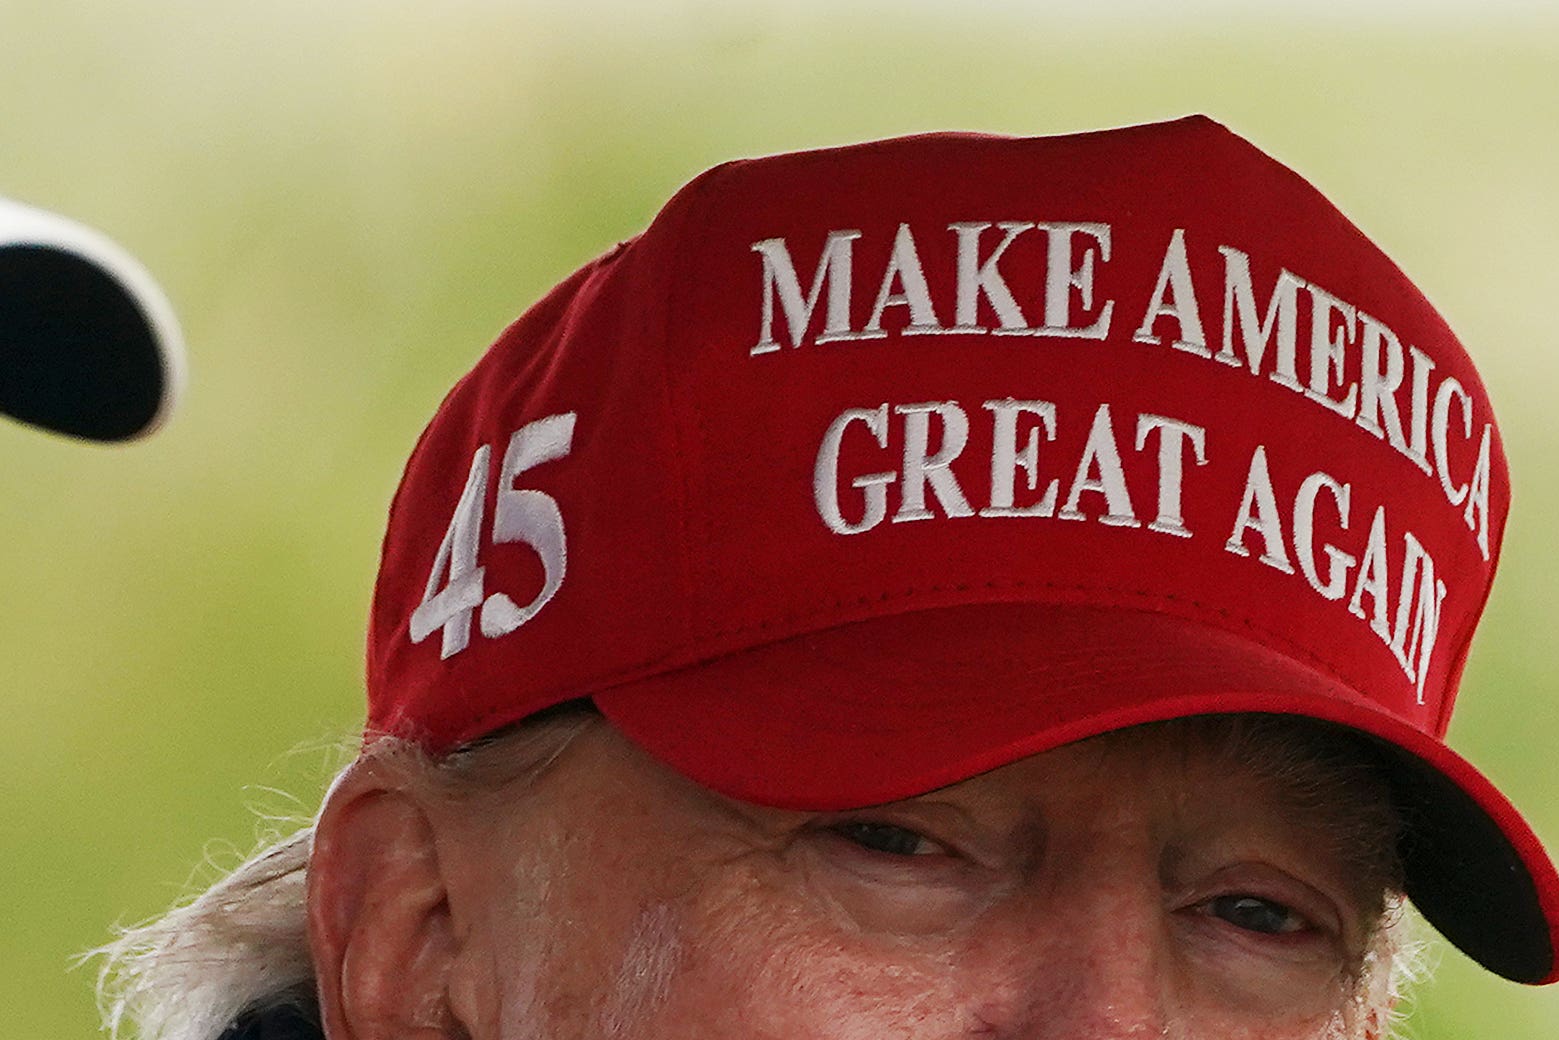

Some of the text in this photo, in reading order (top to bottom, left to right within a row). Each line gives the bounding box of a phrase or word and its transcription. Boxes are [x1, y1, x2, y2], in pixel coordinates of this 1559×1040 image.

[408, 410, 577, 661] 45
[750, 221, 1493, 562] MAKE AMERICA
[813, 397, 1447, 707] GREAT AGAIN
